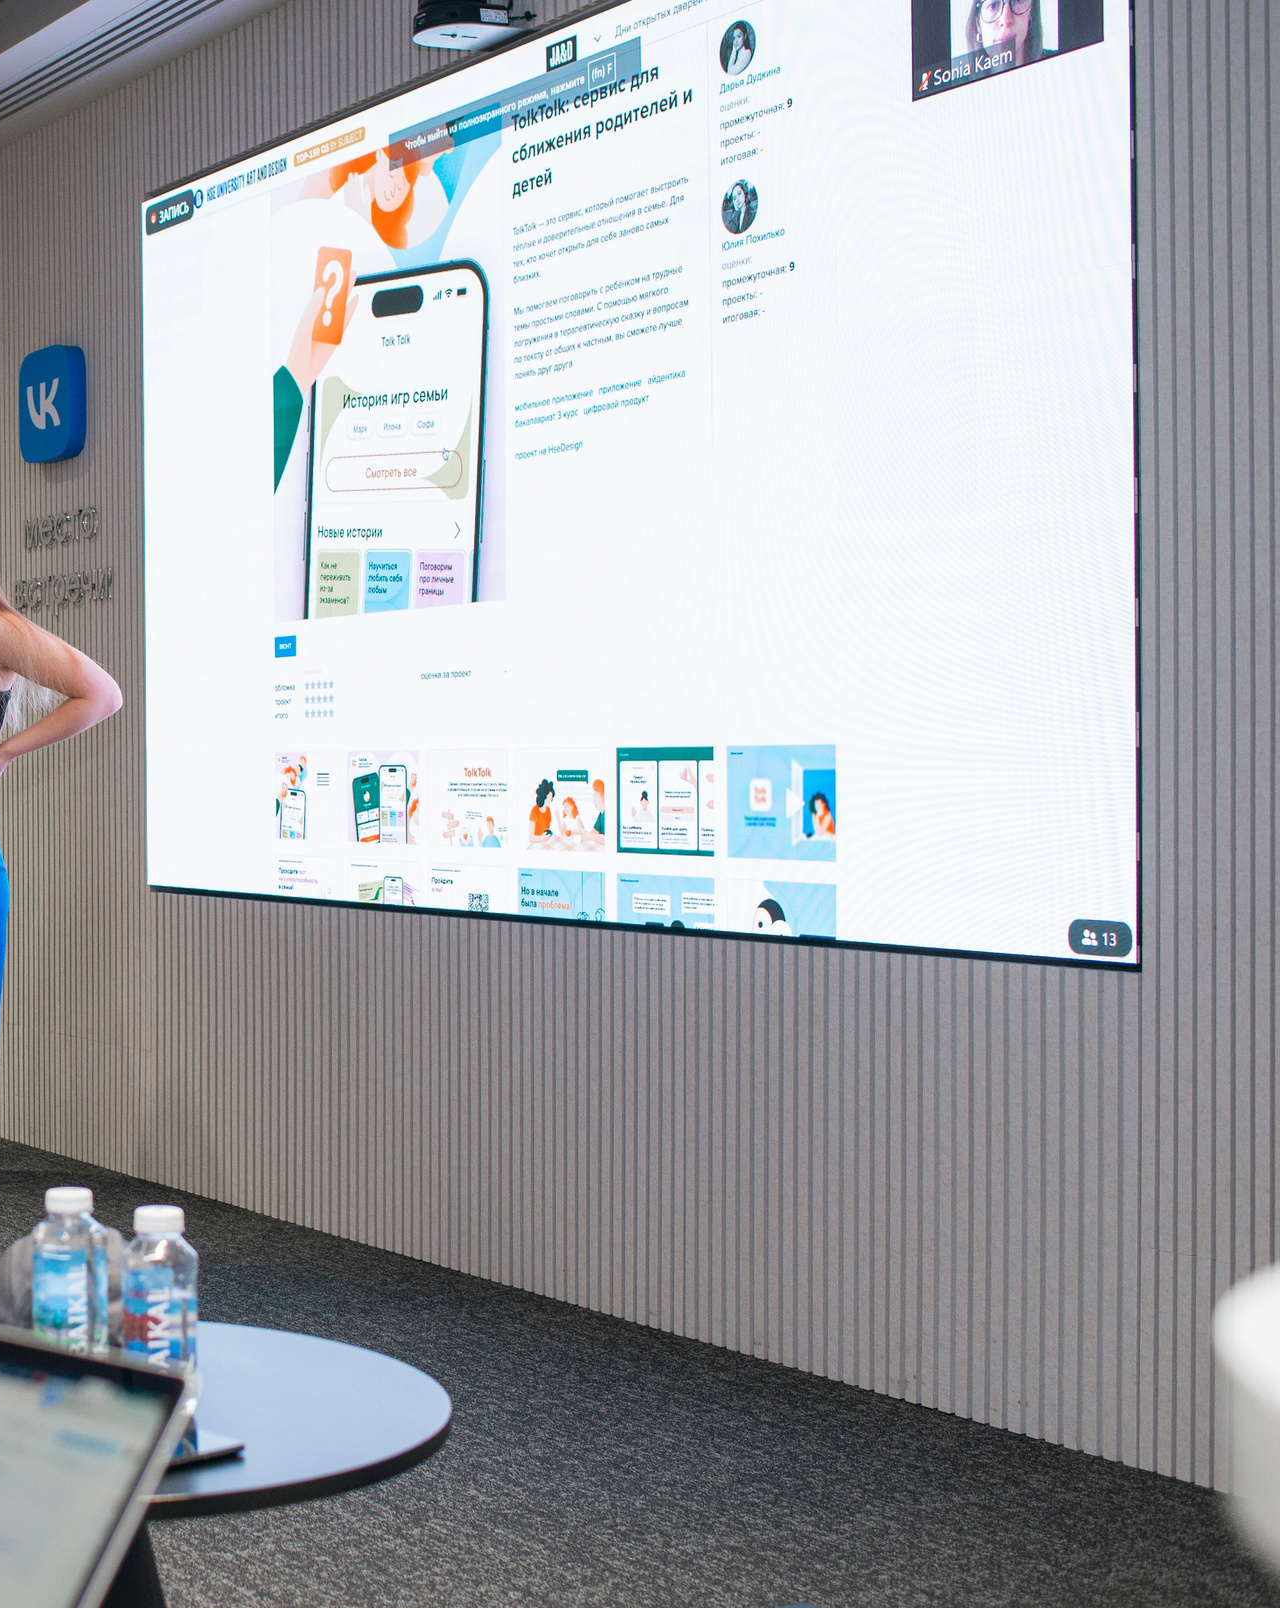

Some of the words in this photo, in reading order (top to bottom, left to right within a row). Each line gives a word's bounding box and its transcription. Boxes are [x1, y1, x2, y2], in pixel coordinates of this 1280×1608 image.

[615, 24, 631, 38] Дни
[633, 10, 671, 31] открытых
[550, 41, 572, 68] JA&D
[933, 62, 970, 86] Sonia
[975, 49, 1012, 73] Kaem
[720, 77, 744, 95] Дарья
[746, 66, 780, 86] Дудкина
[405, 136, 426, 151] Чтобы
[428, 129, 448, 142] выйти
[450, 124, 457, 134] из
[458, 105, 516, 131] полноэкранного
[518, 91, 549, 110] режима,
[551, 75, 585, 96] нажмите
[591, 66, 605, 82] (fn)
[607, 63, 613, 75] F
[511, 101, 569, 132] TolkTolk:
[574, 77, 626, 108] сервис
[630, 66, 659, 92] для
[720, 95, 750, 112] оценки:
[720, 101, 784, 131] промежуточная:
[787, 98, 793, 108] 9
[512, 129, 591, 164] сближения
[596, 90, 678, 135] родителей
[683, 88, 692, 103] и
[720, 130, 755, 148] проекты:
[721, 148, 758, 166] итоговая:
[207, 186, 216, 202] HSE
[217, 175, 245, 198] UNIVERSITY
[247, 170, 256, 187] ART
[258, 166, 267, 181] AND
[269, 157, 287, 178] DESIGN
[512, 167, 552, 199] детей
[159, 201, 189, 224] ЗАПИСЬ
[513, 222, 536, 235] TolkTolk
[546, 217, 556, 226] это
[558, 209, 583, 222] сервис,
[585, 198, 614, 214] который
[616, 189, 648, 204] помогает
[650, 177, 689, 194] выстроить
[513, 240, 536, 251] тёплые
[543, 222, 595, 244] доверительные
[597, 210, 635, 227] отношения
[644, 201, 667, 213] семье.
[670, 195, 684, 206] Для
[538, 250, 556, 260] хочет
[558, 242, 584, 255] открыть
[586, 237, 599, 248] для
[601, 231, 617, 243] себя
[619, 224, 644, 237] заново
[646, 217, 669, 229] самых
[722, 239, 743, 252] Юлия
[746, 228, 785, 245] Похилько
[722, 265, 787, 289] промежуточная:
[789, 262, 795, 271] 9
[514, 307, 523, 315] Мы
[526, 299, 557, 312] помогаем
[559, 289, 597, 304] поговорить
[605, 277, 640, 294] ребёнком
[642, 274, 650, 282] на
[652, 266, 683, 280] трудные
[722, 292, 757, 307] проекты:
[514, 322, 530, 331] темы
[532, 314, 563, 327] простыми
[597, 302, 602, 311] С
[604, 295, 637, 309] помощью
[639, 287, 668, 300] мягкого
[722, 309, 760, 324] итоговая:
[514, 333, 552, 347] погружения
[560, 317, 619, 337] терапевтическую
[621, 311, 644, 322] сказку
[653, 299, 689, 314] вопросам
[382, 336, 395, 348] Tolk
[397, 334, 410, 345] Tolk
[524, 352, 543, 361] тексту
[554, 344, 575, 354] общих
[583, 335, 613, 347] частным,
[627, 325, 657, 337] сможете
[659, 318, 682, 331] лучше
[515, 370, 536, 379] понять
[538, 365, 552, 376] друг
[554, 361, 573, 372] друга
[343, 394, 387, 410] История
[391, 393, 409, 408] игр
[413, 388, 448, 402] семьи
[515, 399, 550, 411] мобильное
[552, 390, 593, 404] приложение
[599, 380, 642, 395] приложение
[648, 370, 685, 384] айдентика
[515, 414, 555, 428] бакалавриат
[557, 410, 561, 419] 3
[563, 409, 578, 419] курс
[583, 400, 619, 415] цифровой
[621, 395, 649, 408] продукт
[353, 425, 367, 434] Марк
[384, 423, 401, 431] Илона
[418, 420, 434, 429] Софа
[515, 450, 537, 460] проект
[548, 442, 582, 454] HseDesign
[365, 468, 401, 480] Смотреть
[404, 468, 417, 477] все
[318, 526, 344, 538] Новые
[347, 527, 382, 540] истории
[369, 562, 397, 571] Научиться
[420, 562, 452, 572] Поговорим
[389, 574, 402, 582] себя
[420, 575, 429, 584] про
[368, 586, 387, 594] любым
[419, 588, 444, 596] границы
[421, 672, 441, 680] оценка
[443, 671, 449, 679] за
[451, 669, 471, 679] проект
[464, 768, 491, 777] TolkTolk
[521, 887, 530, 895] Но
[521, 898, 537, 907] была
[1102, 932, 1117, 946] 13
[147, 1286, 171, 1372] AIKAL
